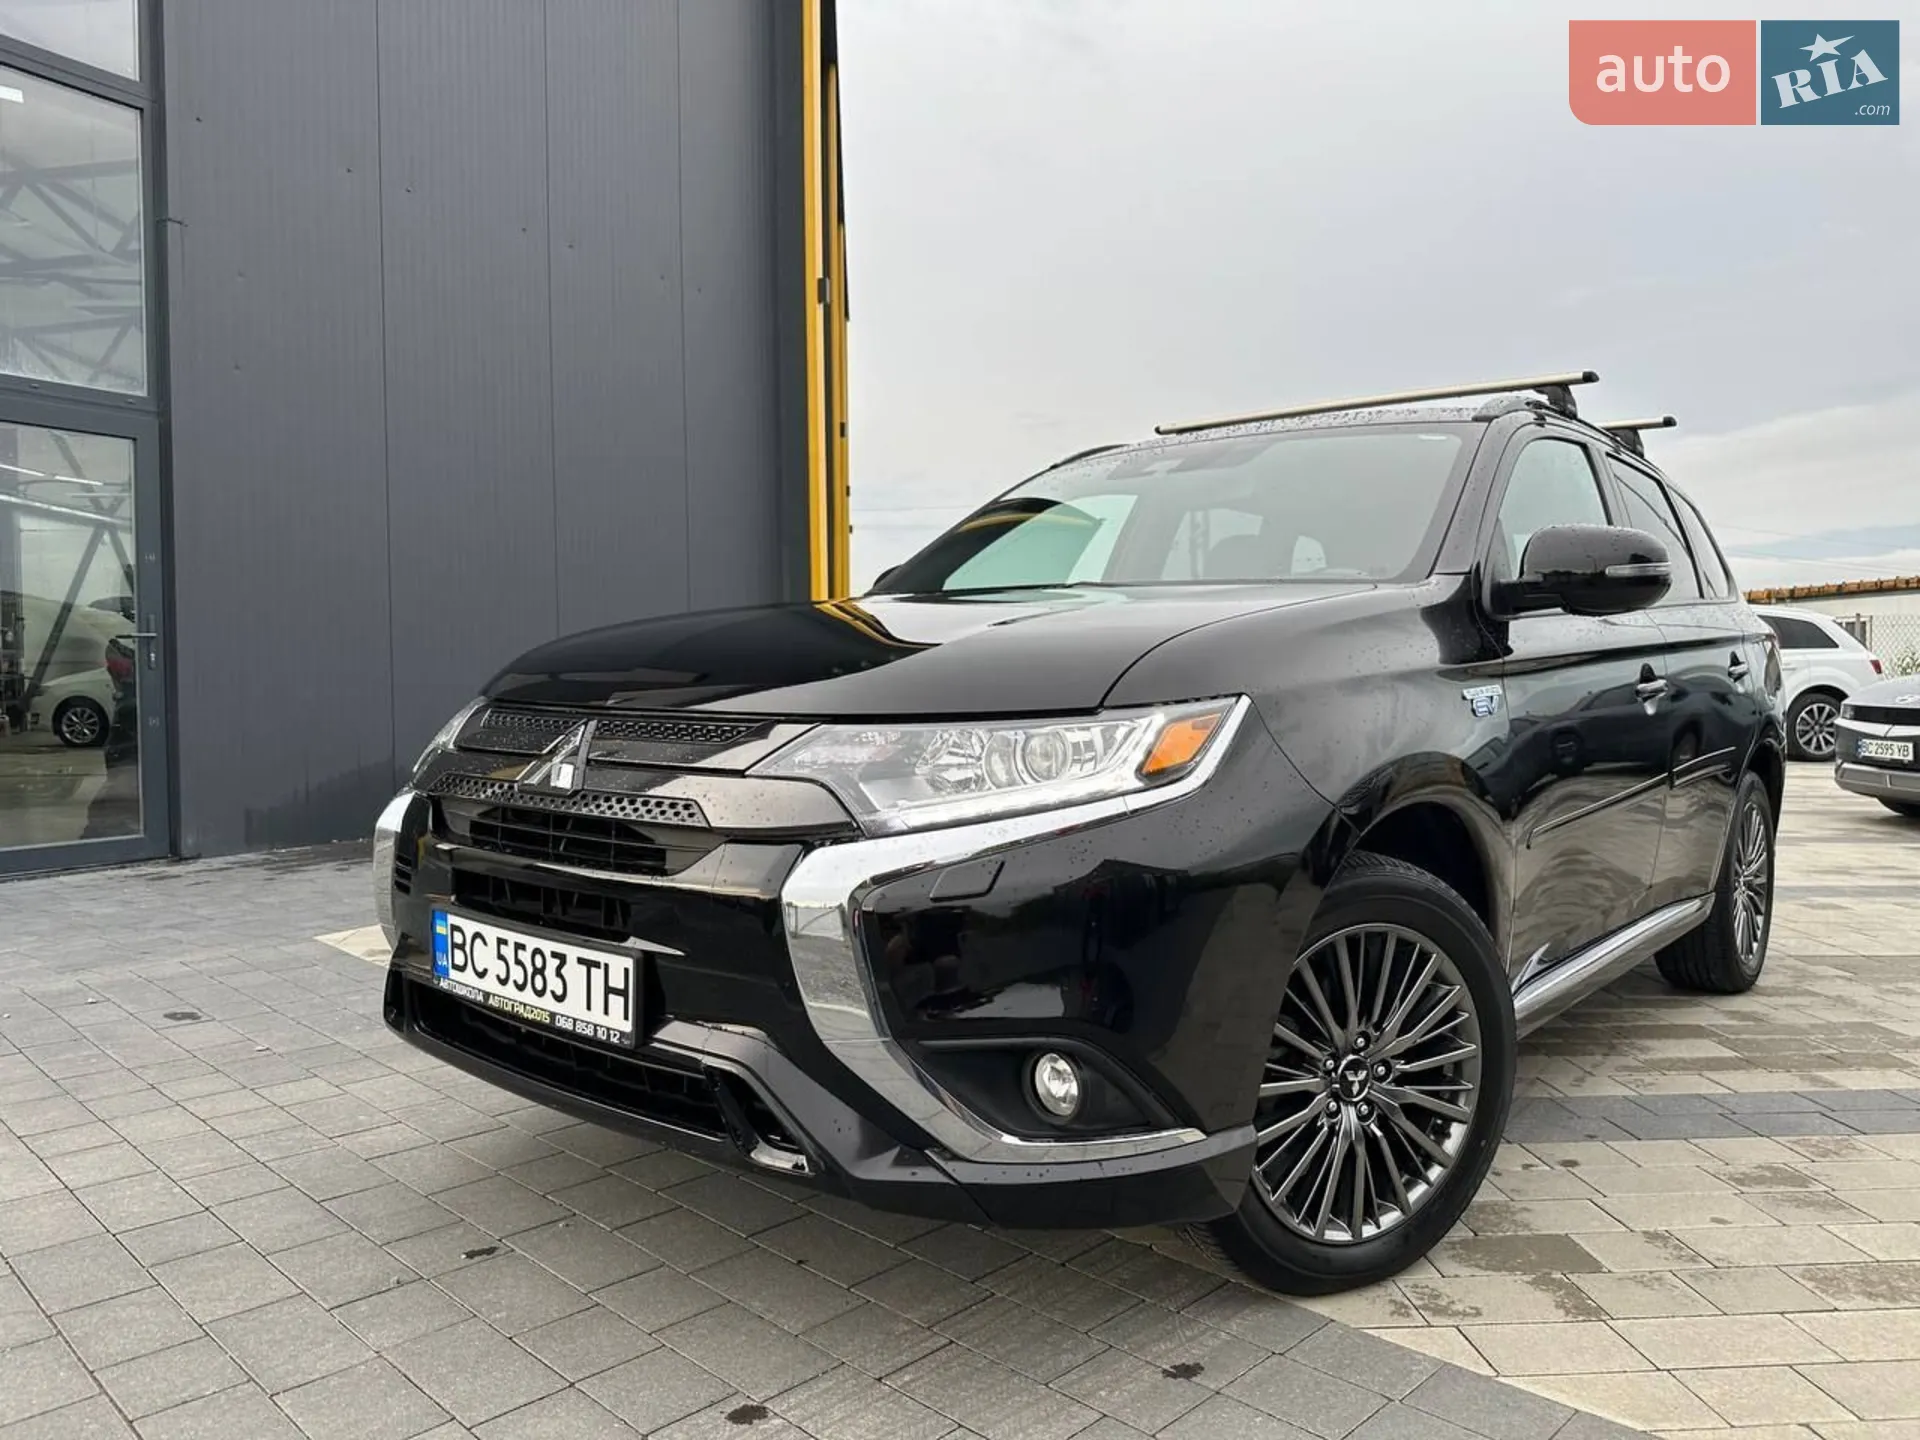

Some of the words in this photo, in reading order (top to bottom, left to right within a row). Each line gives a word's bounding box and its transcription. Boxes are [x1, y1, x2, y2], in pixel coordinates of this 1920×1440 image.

[1861, 741, 1874, 754] BC
[1874, 742, 1895, 756] 2595
[436, 952, 448, 967] UA
[450, 924, 488, 979] BC
[495, 936, 568, 1003] 5583
[576, 957, 630, 1022] TH
[555, 1015, 574, 1030] 068
[596, 1026, 607, 1040] 10
[609, 1030, 620, 1043] 12
